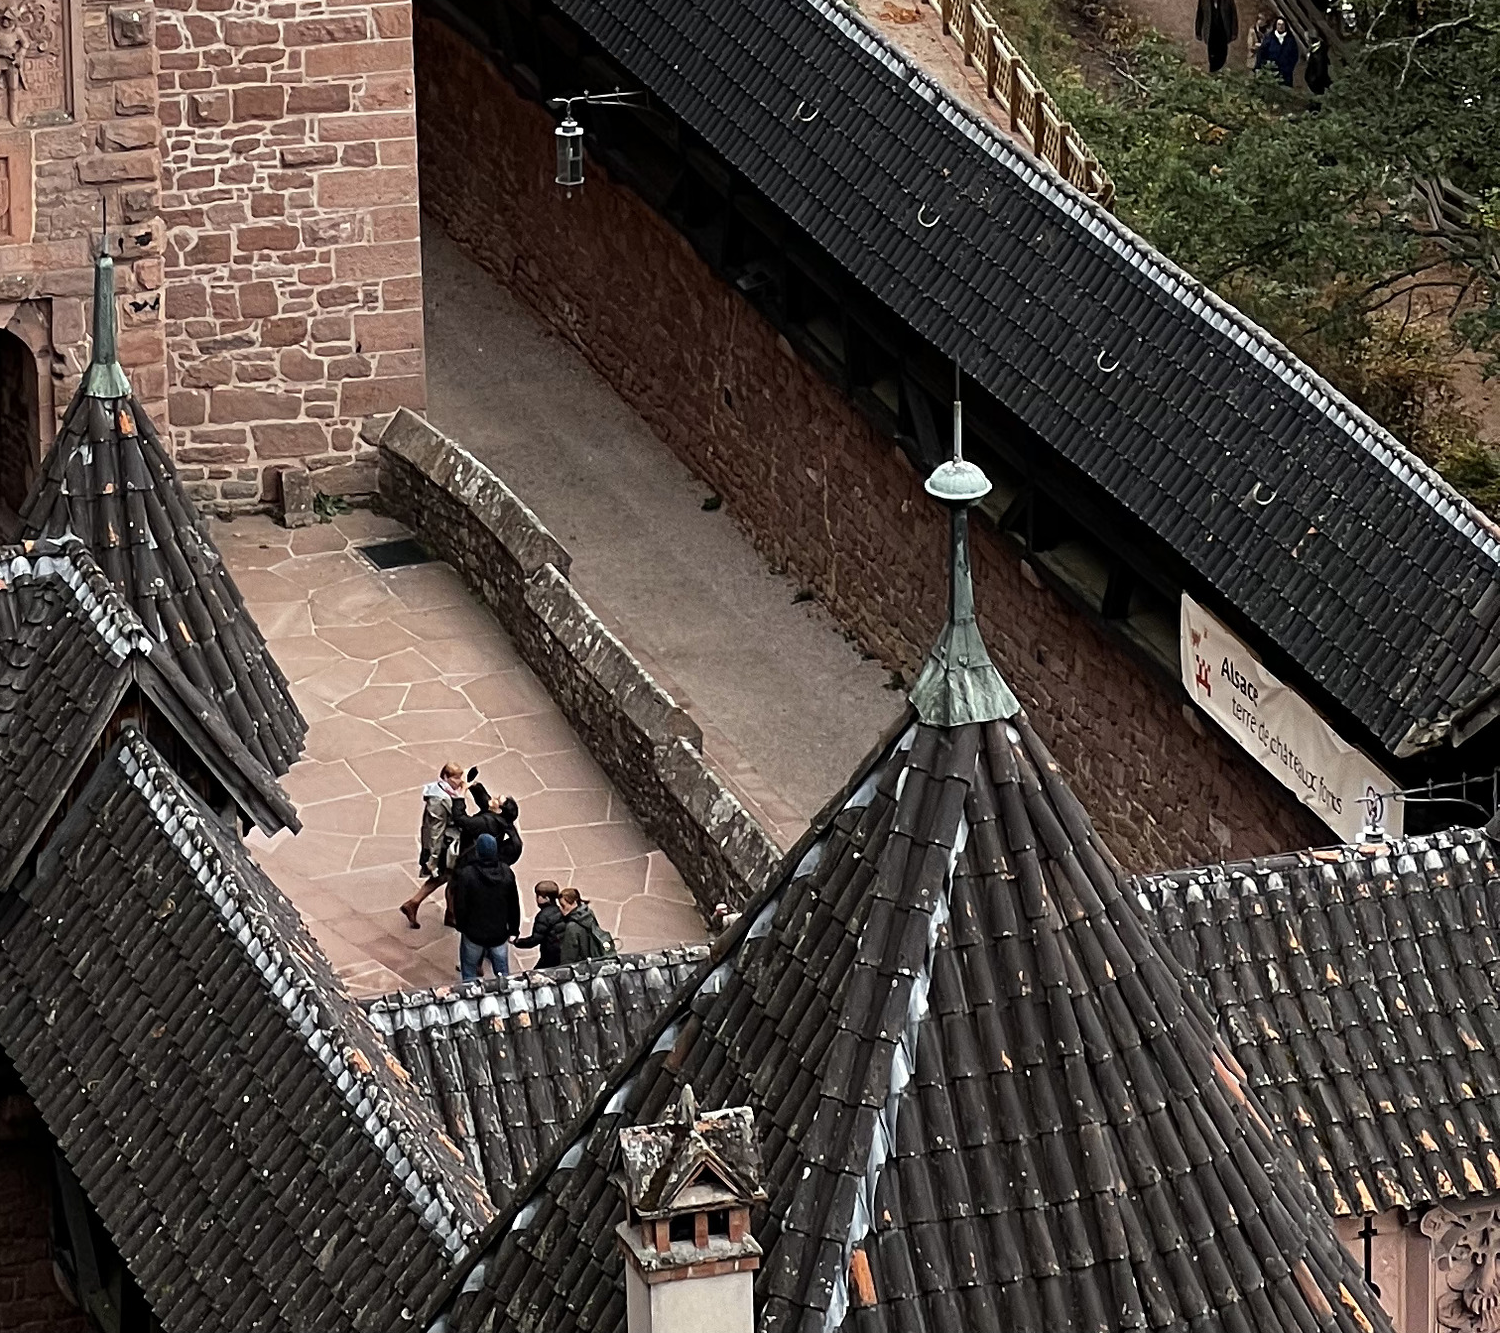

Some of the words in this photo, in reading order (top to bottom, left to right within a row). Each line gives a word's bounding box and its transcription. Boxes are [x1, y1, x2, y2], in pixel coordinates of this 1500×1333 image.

[1221, 657, 1259, 707] Alsace
[1232, 696, 1257, 733] terre
[1258, 722, 1270, 747] de
[1319, 776, 1343, 815] forts
